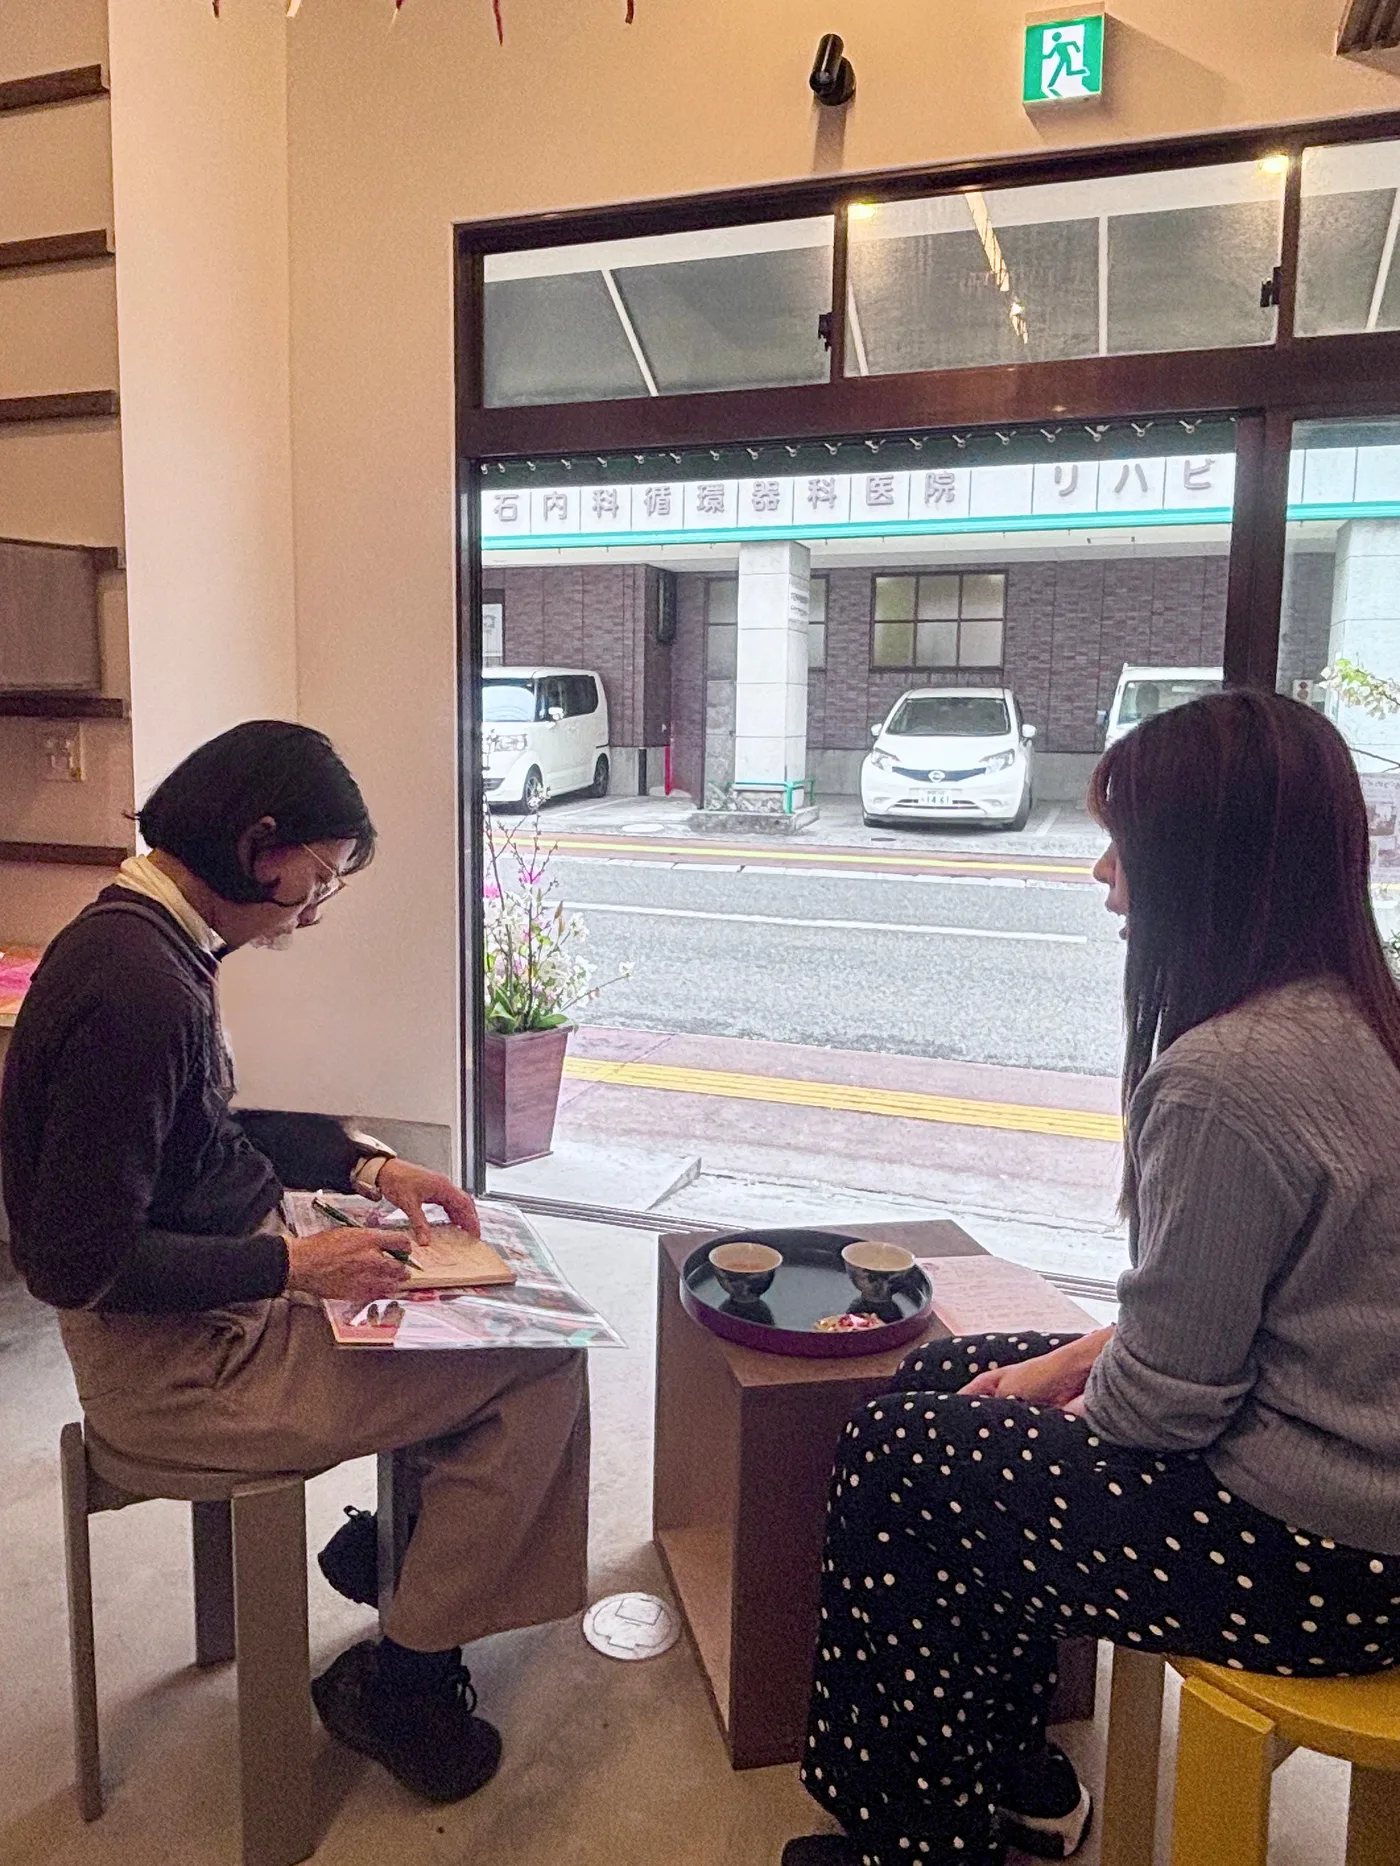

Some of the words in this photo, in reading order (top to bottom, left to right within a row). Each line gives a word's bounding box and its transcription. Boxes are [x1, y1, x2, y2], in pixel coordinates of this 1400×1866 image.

[493, 471, 956, 522] 石内科循環器科医院
[1054, 457, 1216, 497] リハビ
